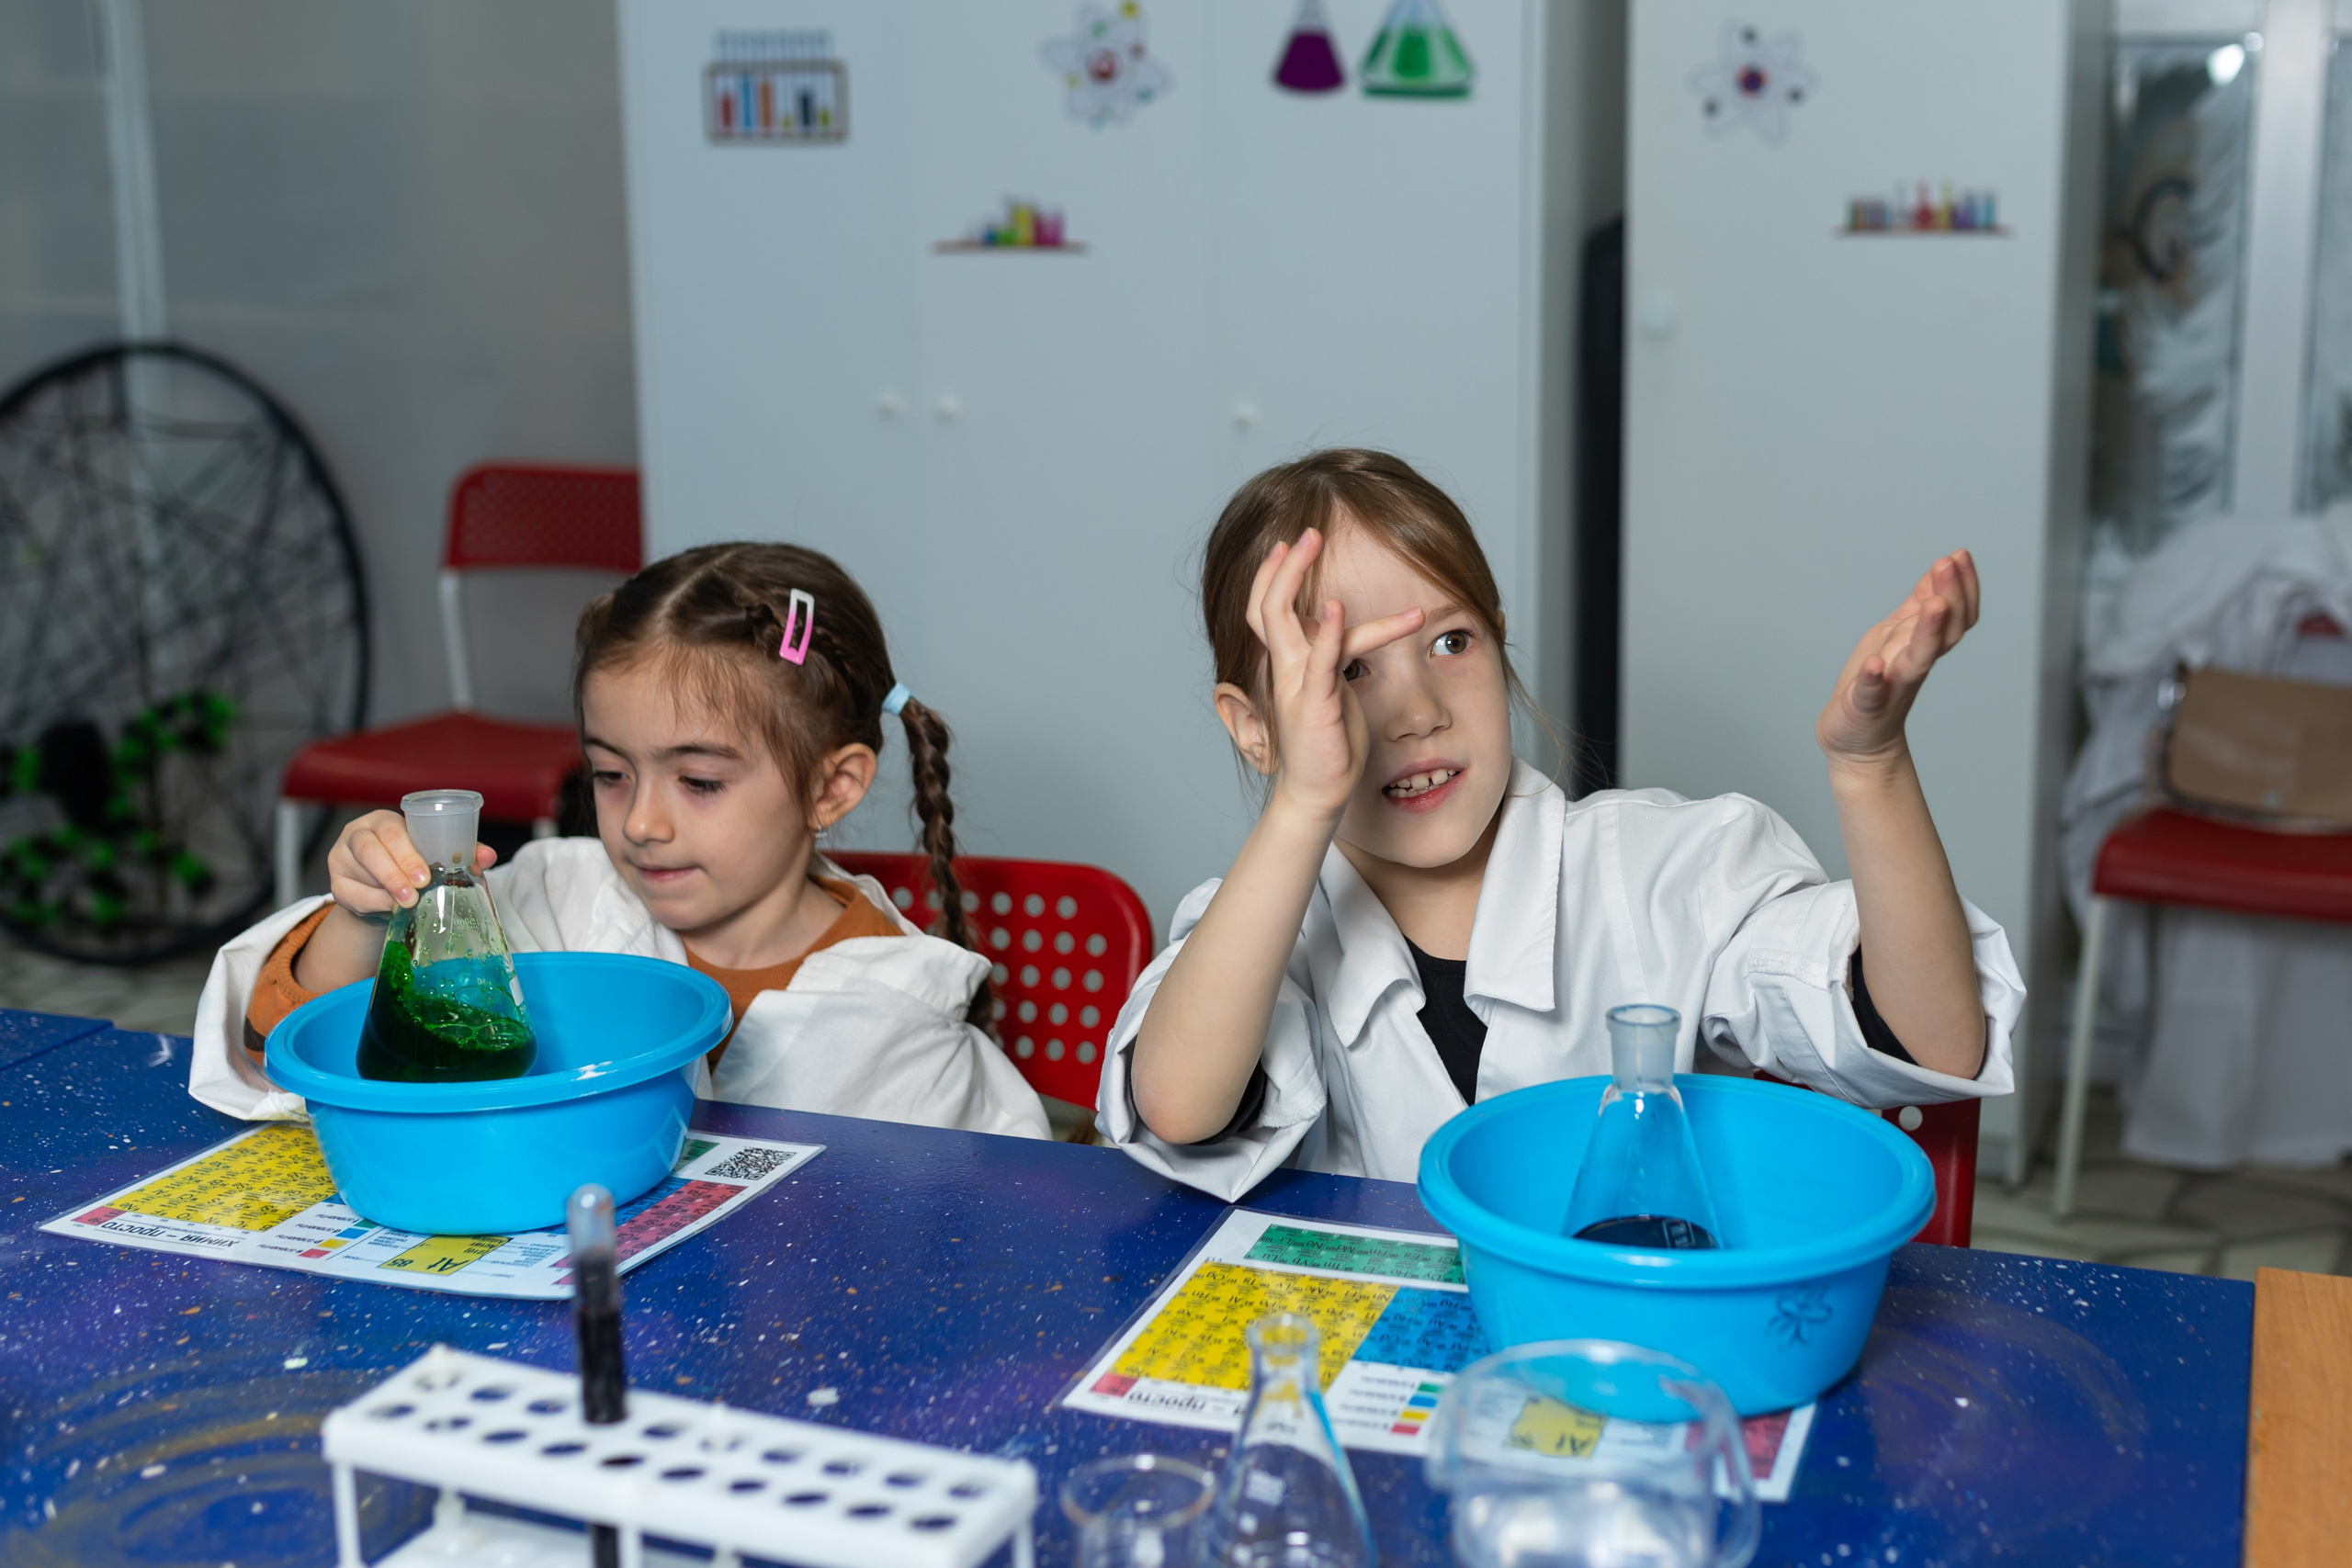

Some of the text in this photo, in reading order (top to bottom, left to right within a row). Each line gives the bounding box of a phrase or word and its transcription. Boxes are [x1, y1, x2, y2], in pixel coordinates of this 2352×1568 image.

[102, 1223, 164, 1236] просто
[388, 1258, 469, 1272] At 85
